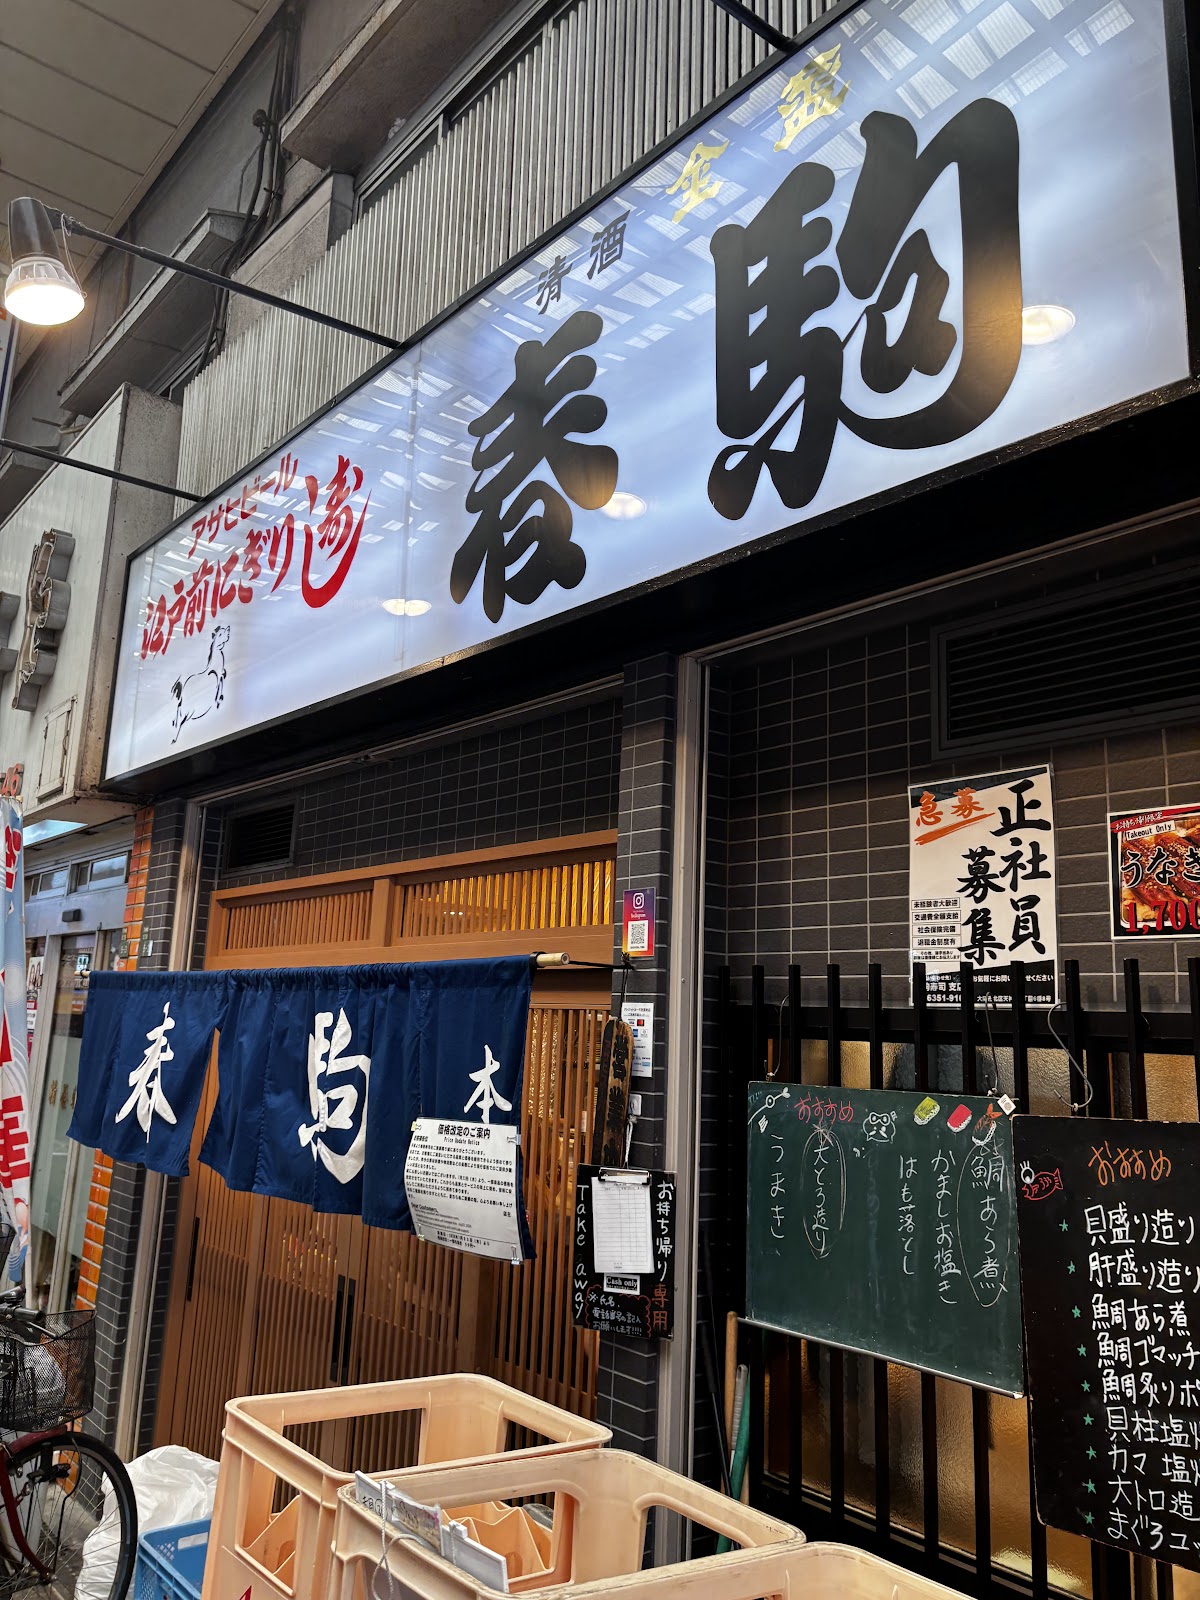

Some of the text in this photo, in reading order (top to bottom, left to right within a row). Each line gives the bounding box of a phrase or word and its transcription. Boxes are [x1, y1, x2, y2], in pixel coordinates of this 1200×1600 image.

[538, 210, 630, 315] 清酒
[450, 97, 1023, 623] 春駒
[187, 452, 298, 559] アサヒビール
[915, 787, 984, 826] 急募
[1126, 823, 1172, 840] Takeout Only
[990, 779, 1052, 955] 正社員
[956, 846, 1007, 967] 募集
[437, 1123, 491, 1140] 価格改定のご案内
[794, 1091, 855, 1125] おすすめ
[770, 1134, 786, 1239] うまき
[812, 1142, 830, 1256] 大とろ造り
[1088, 1141, 1172, 1186] おすすめ
[573, 1184, 590, 1319] Take away
[898, 1154, 919, 1275] はも落とし
[971, 1154, 1008, 1293] 鯛あら煮
[1084, 1201, 1196, 1247] 貝盛り造り
[606, 1276, 623, 1286] Cash
[623, 1279, 638, 1289] only
[1088, 1248, 1200, 1294] 肝盛り造り
[1092, 1293, 1191, 1337] 鯛あら煮
[1107, 1443, 1147, 1475] カマ
